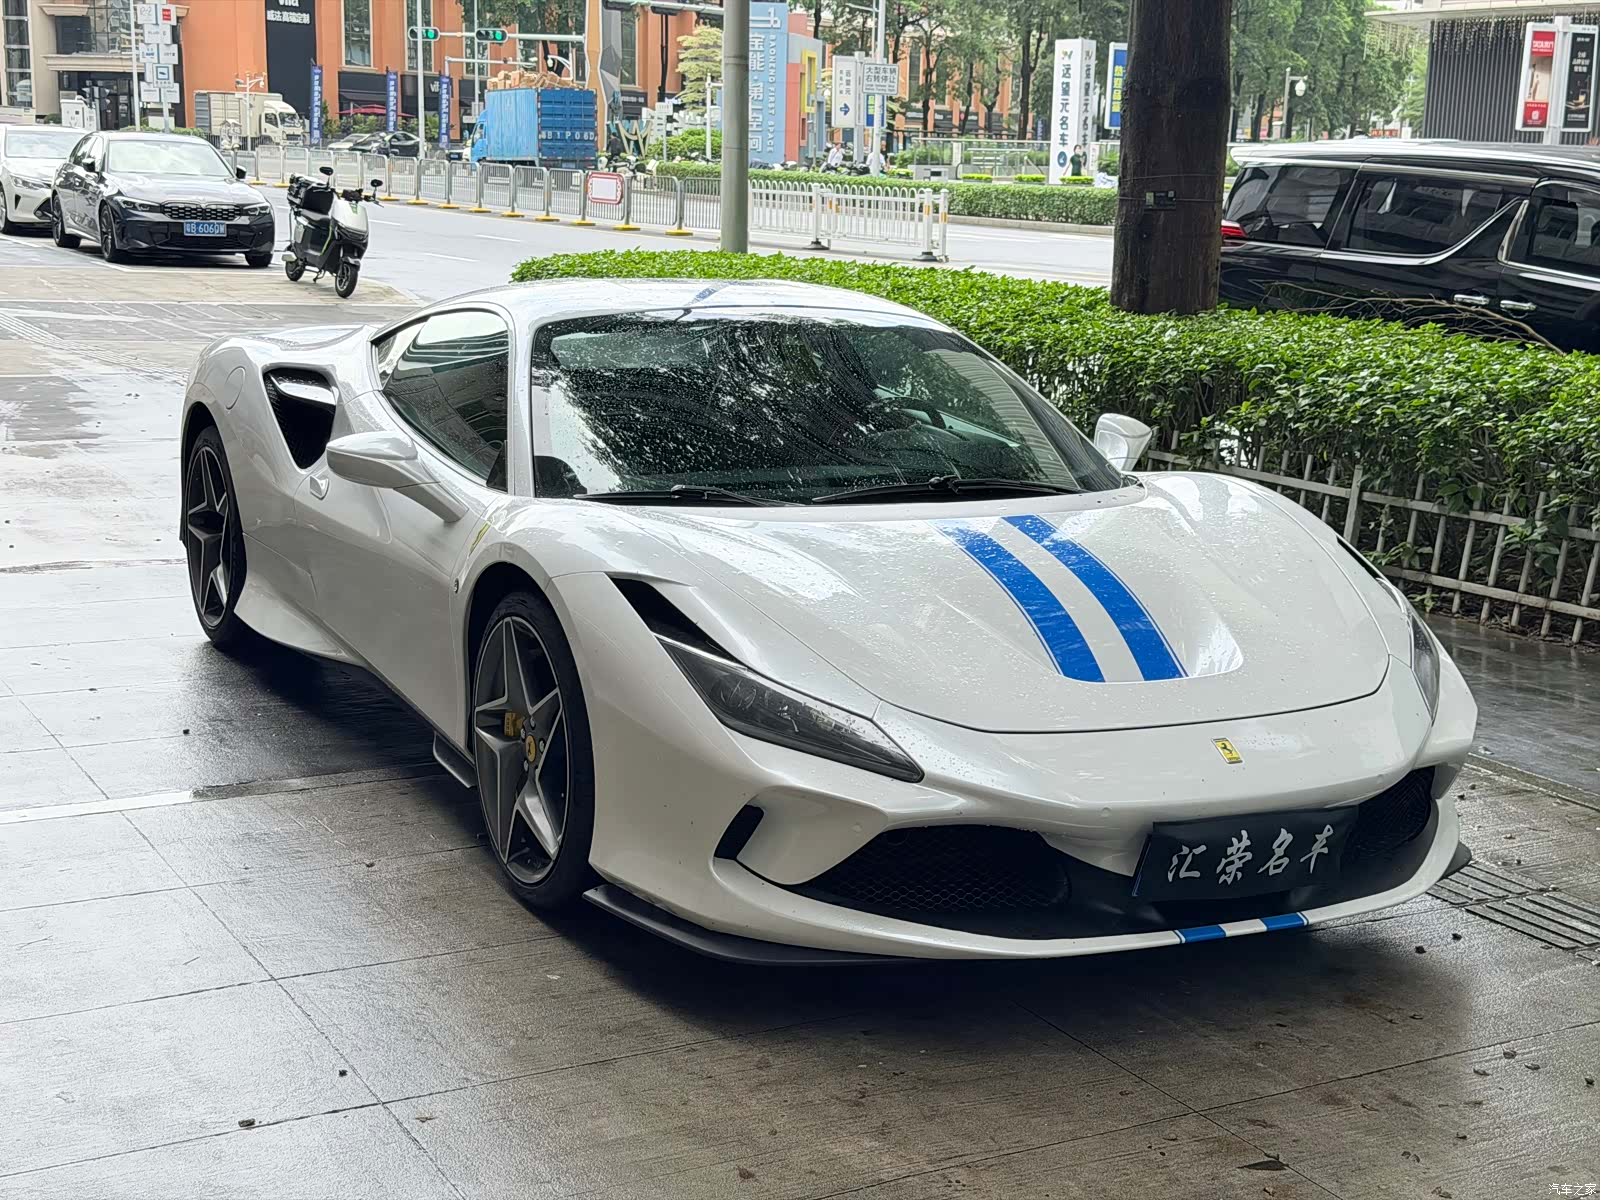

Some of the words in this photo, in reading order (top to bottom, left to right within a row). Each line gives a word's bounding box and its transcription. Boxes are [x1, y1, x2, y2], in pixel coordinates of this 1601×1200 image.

[865, 75, 896, 83] 右转停让
[866, 66, 896, 75] 大型车辆
[768, 87, 776, 116] FIRST
[1059, 64, 1071, 146] 远望元名车
[767, 120, 775, 153] SPACE
[1167, 824, 1334, 885] 汇荣名车
